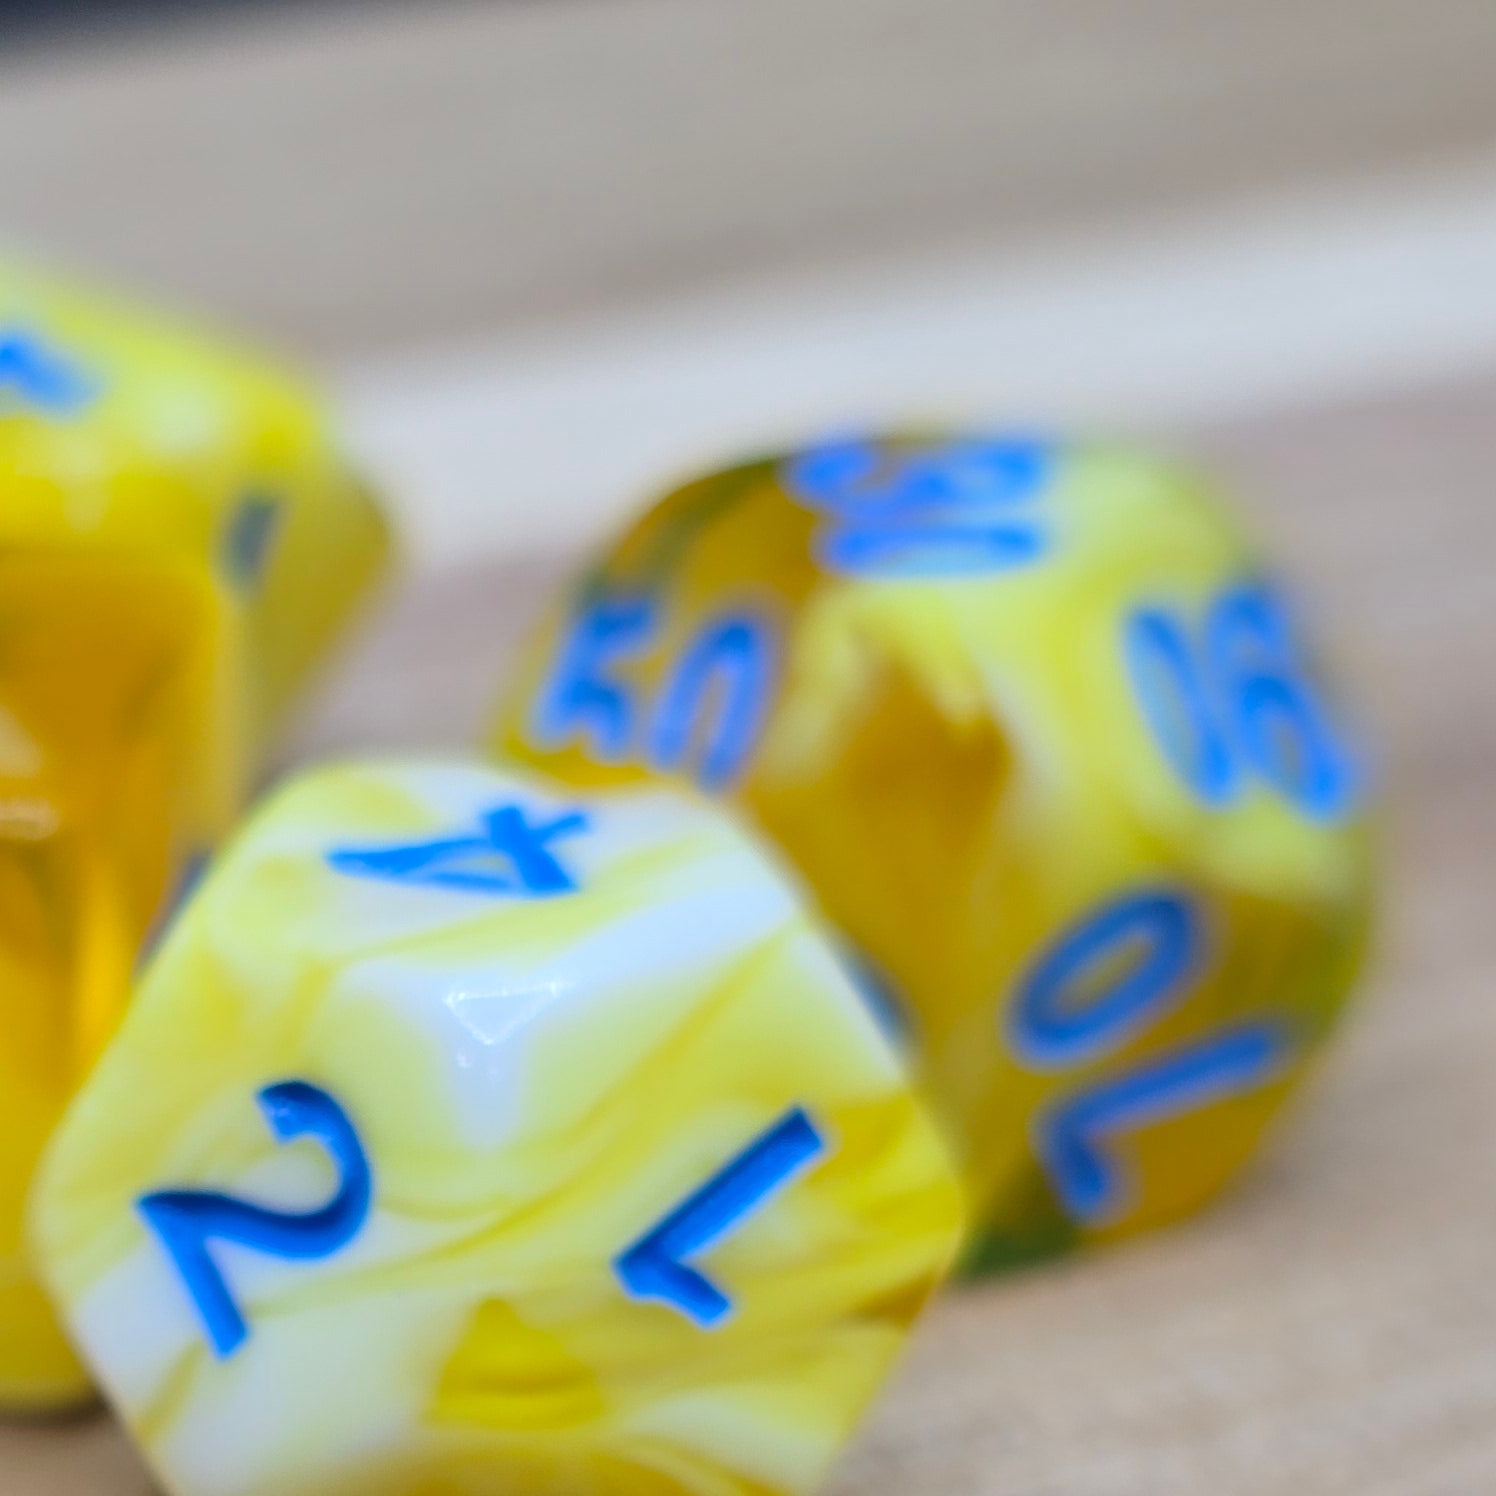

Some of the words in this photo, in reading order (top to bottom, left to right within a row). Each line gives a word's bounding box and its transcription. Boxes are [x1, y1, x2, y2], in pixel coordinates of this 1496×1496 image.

[324, 803, 594, 899] 4
[134, 1080, 376, 1363] 2
[612, 1106, 828, 1330] 1
